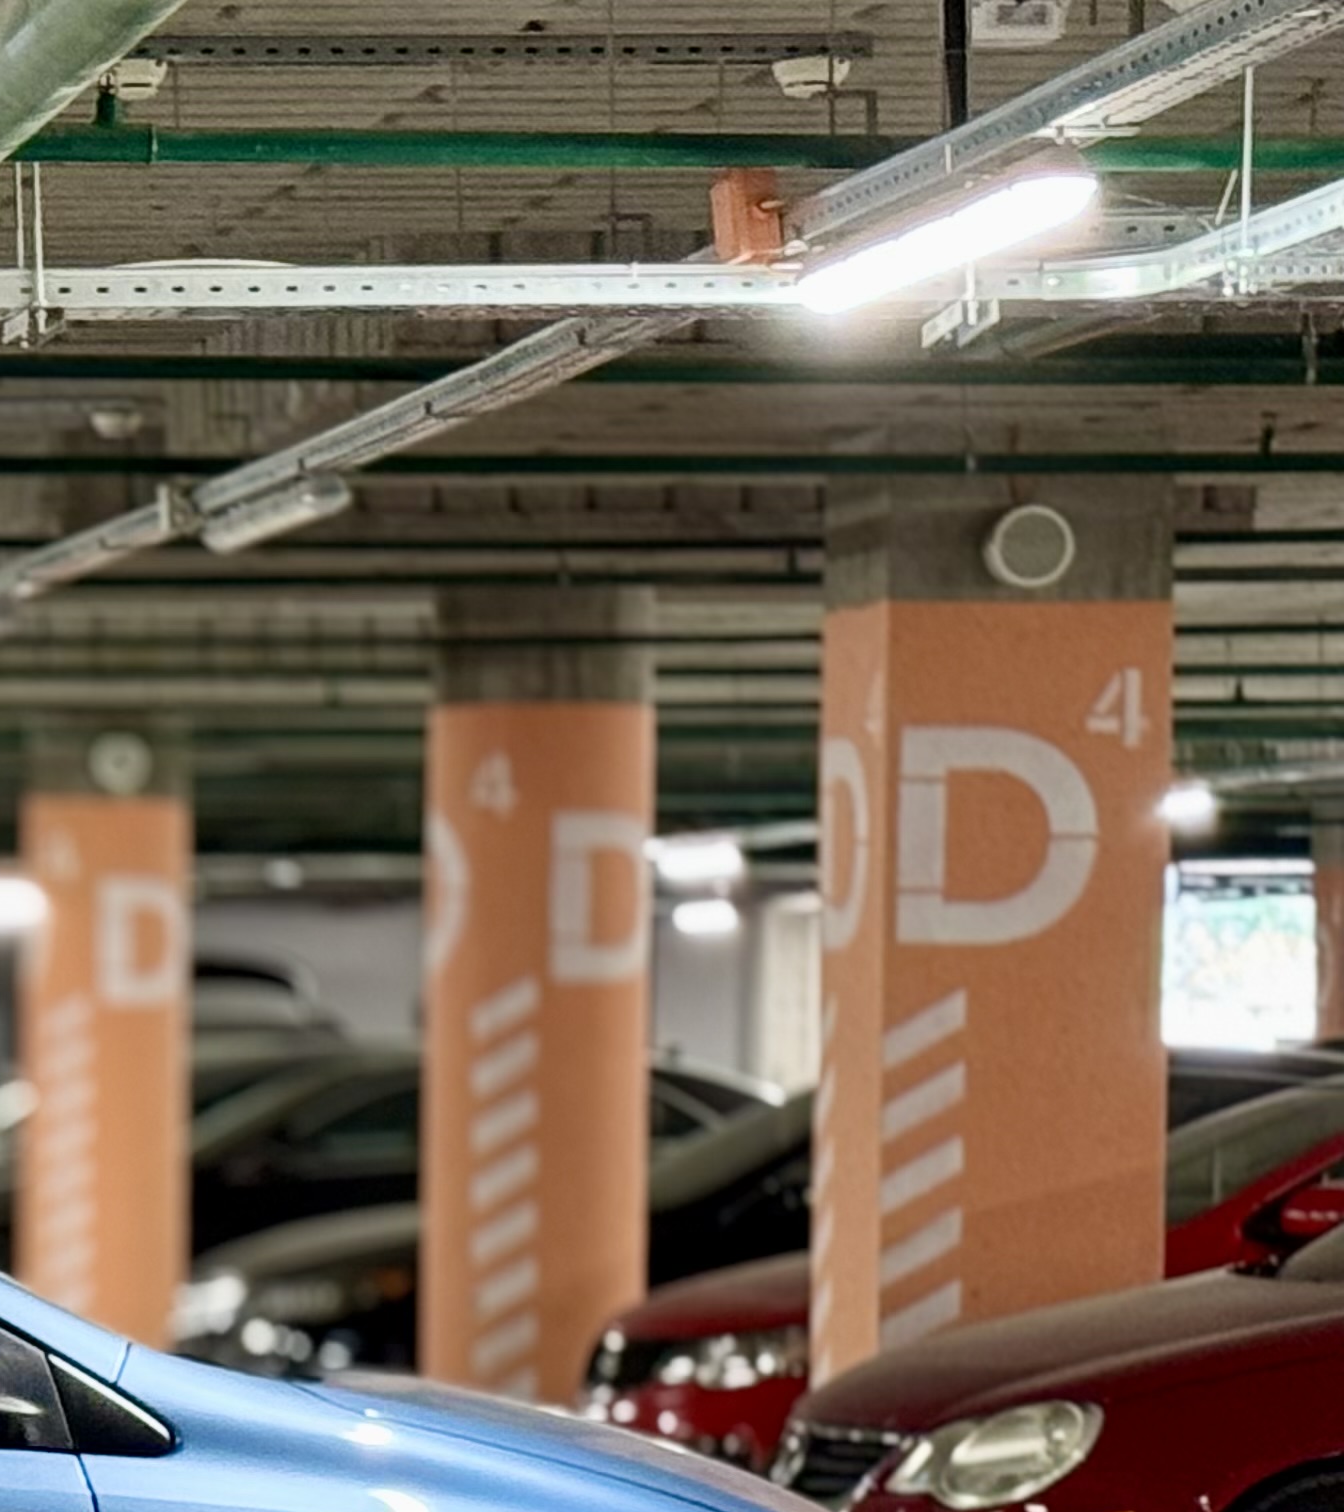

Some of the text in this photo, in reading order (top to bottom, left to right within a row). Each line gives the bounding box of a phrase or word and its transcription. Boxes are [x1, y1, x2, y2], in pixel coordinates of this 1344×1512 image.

[1086, 666, 1148, 748] 4
[549, 810, 648, 983] D
[896, 725, 1099, 946] D
[96, 875, 190, 1004] D
